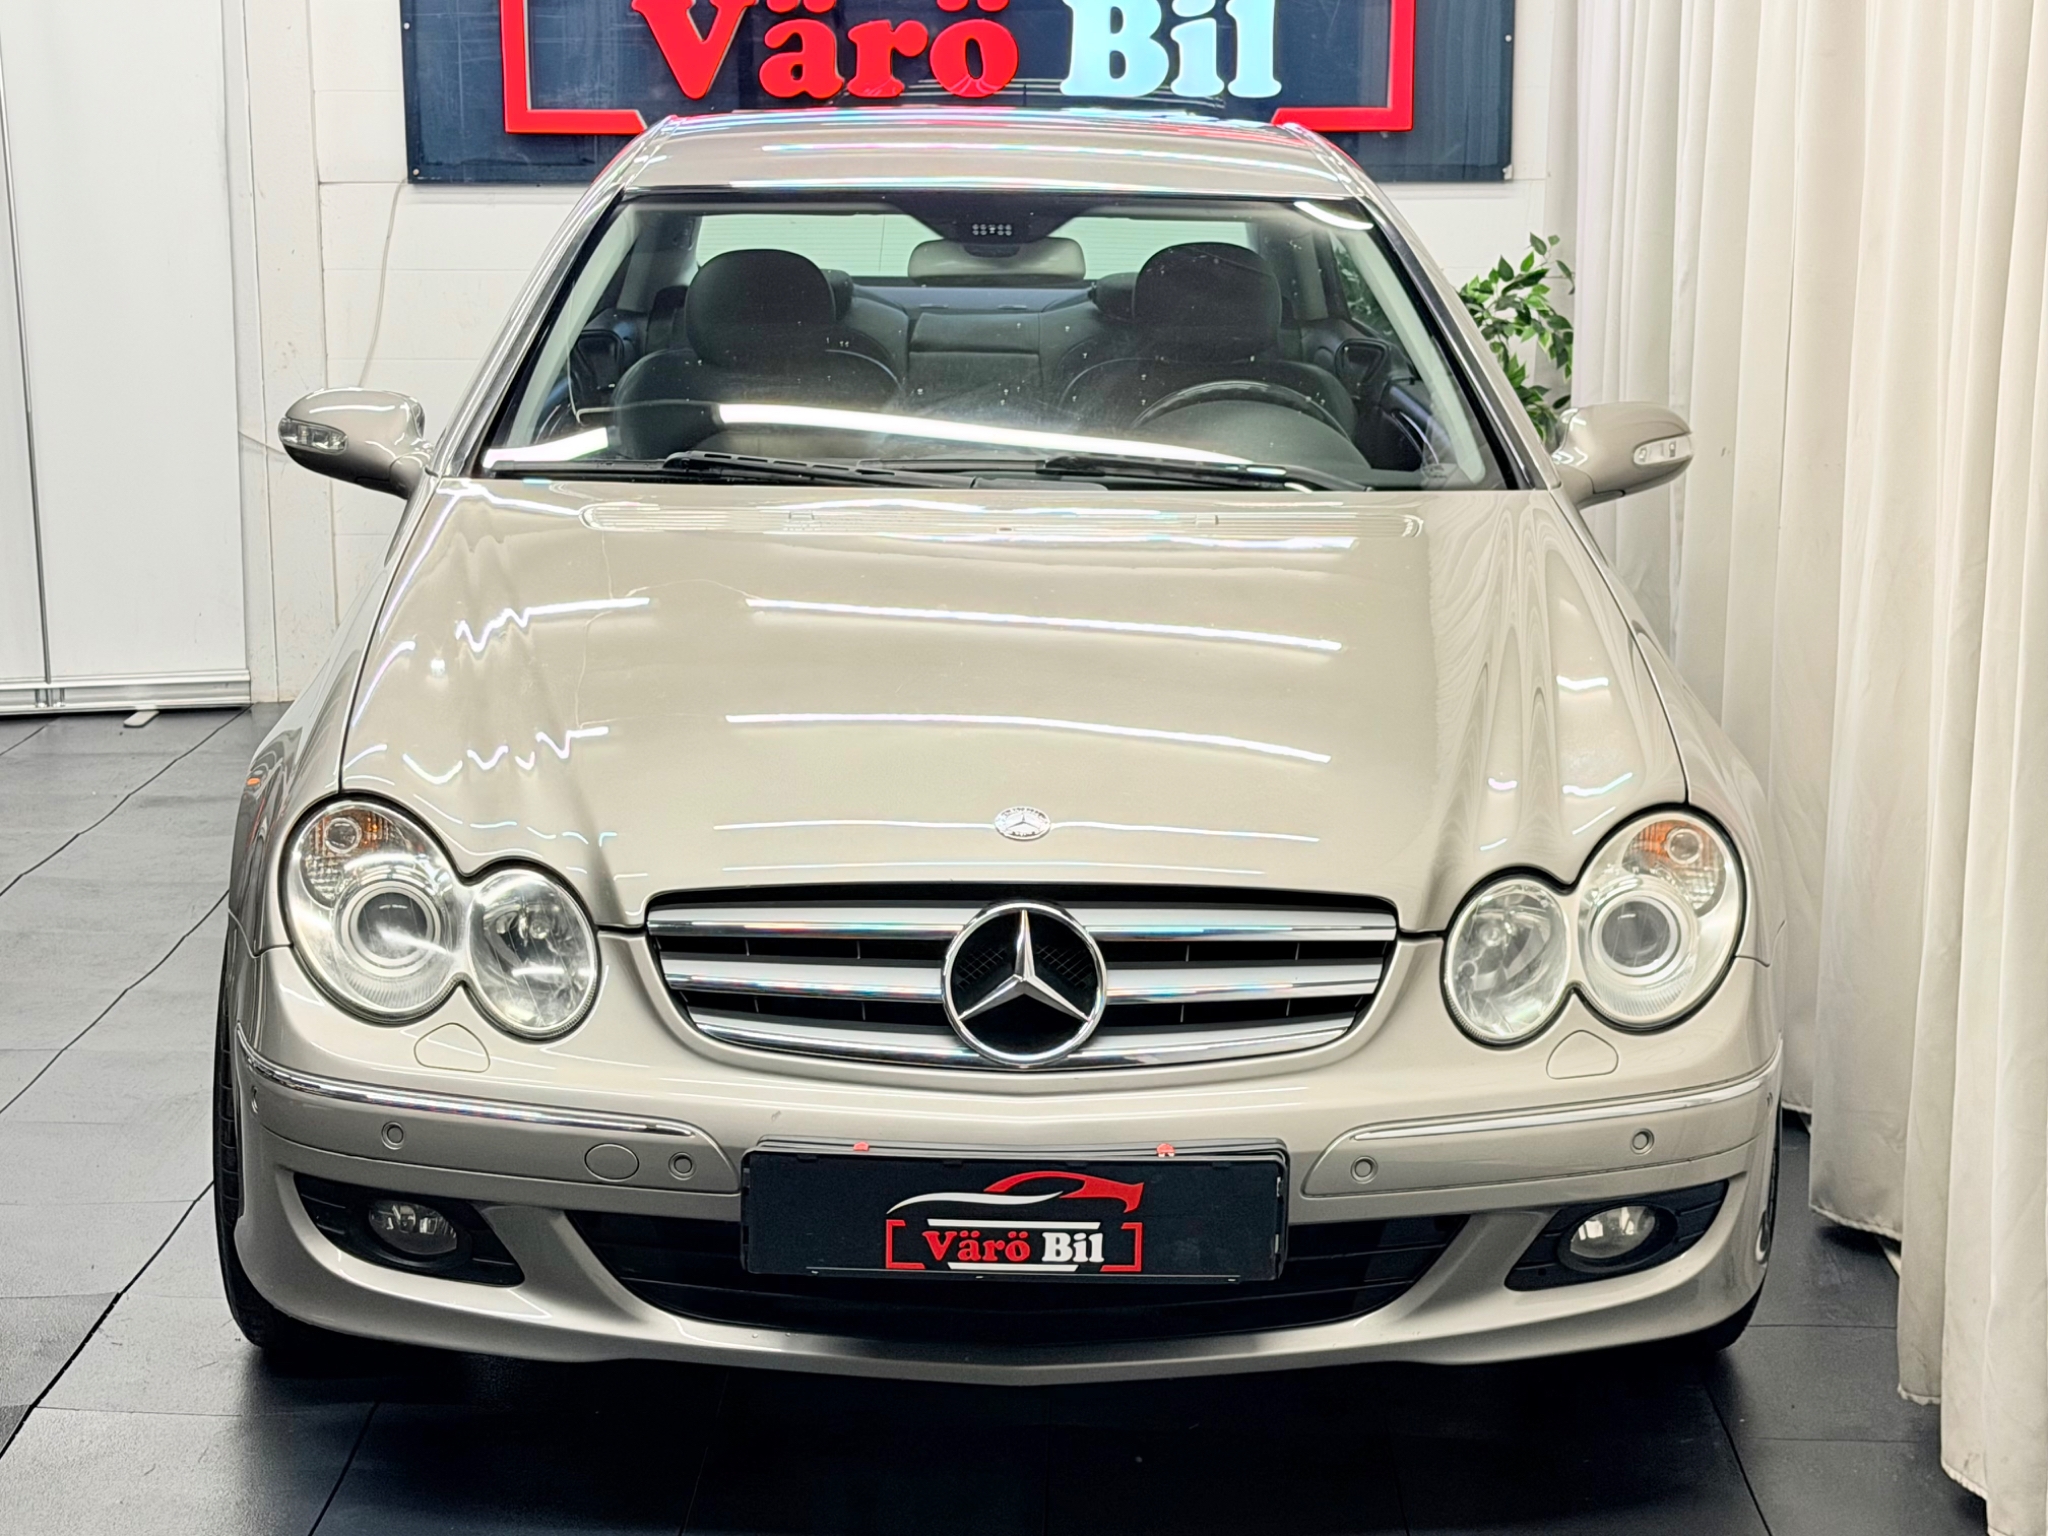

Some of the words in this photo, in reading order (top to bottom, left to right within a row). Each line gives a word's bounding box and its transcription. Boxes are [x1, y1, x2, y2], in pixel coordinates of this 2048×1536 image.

[631, 0, 1020, 101] Värö
[1061, 0, 1282, 98] Bil
[922, 1230, 1031, 1262] Värö
[1041, 1231, 1105, 1263] Bil
